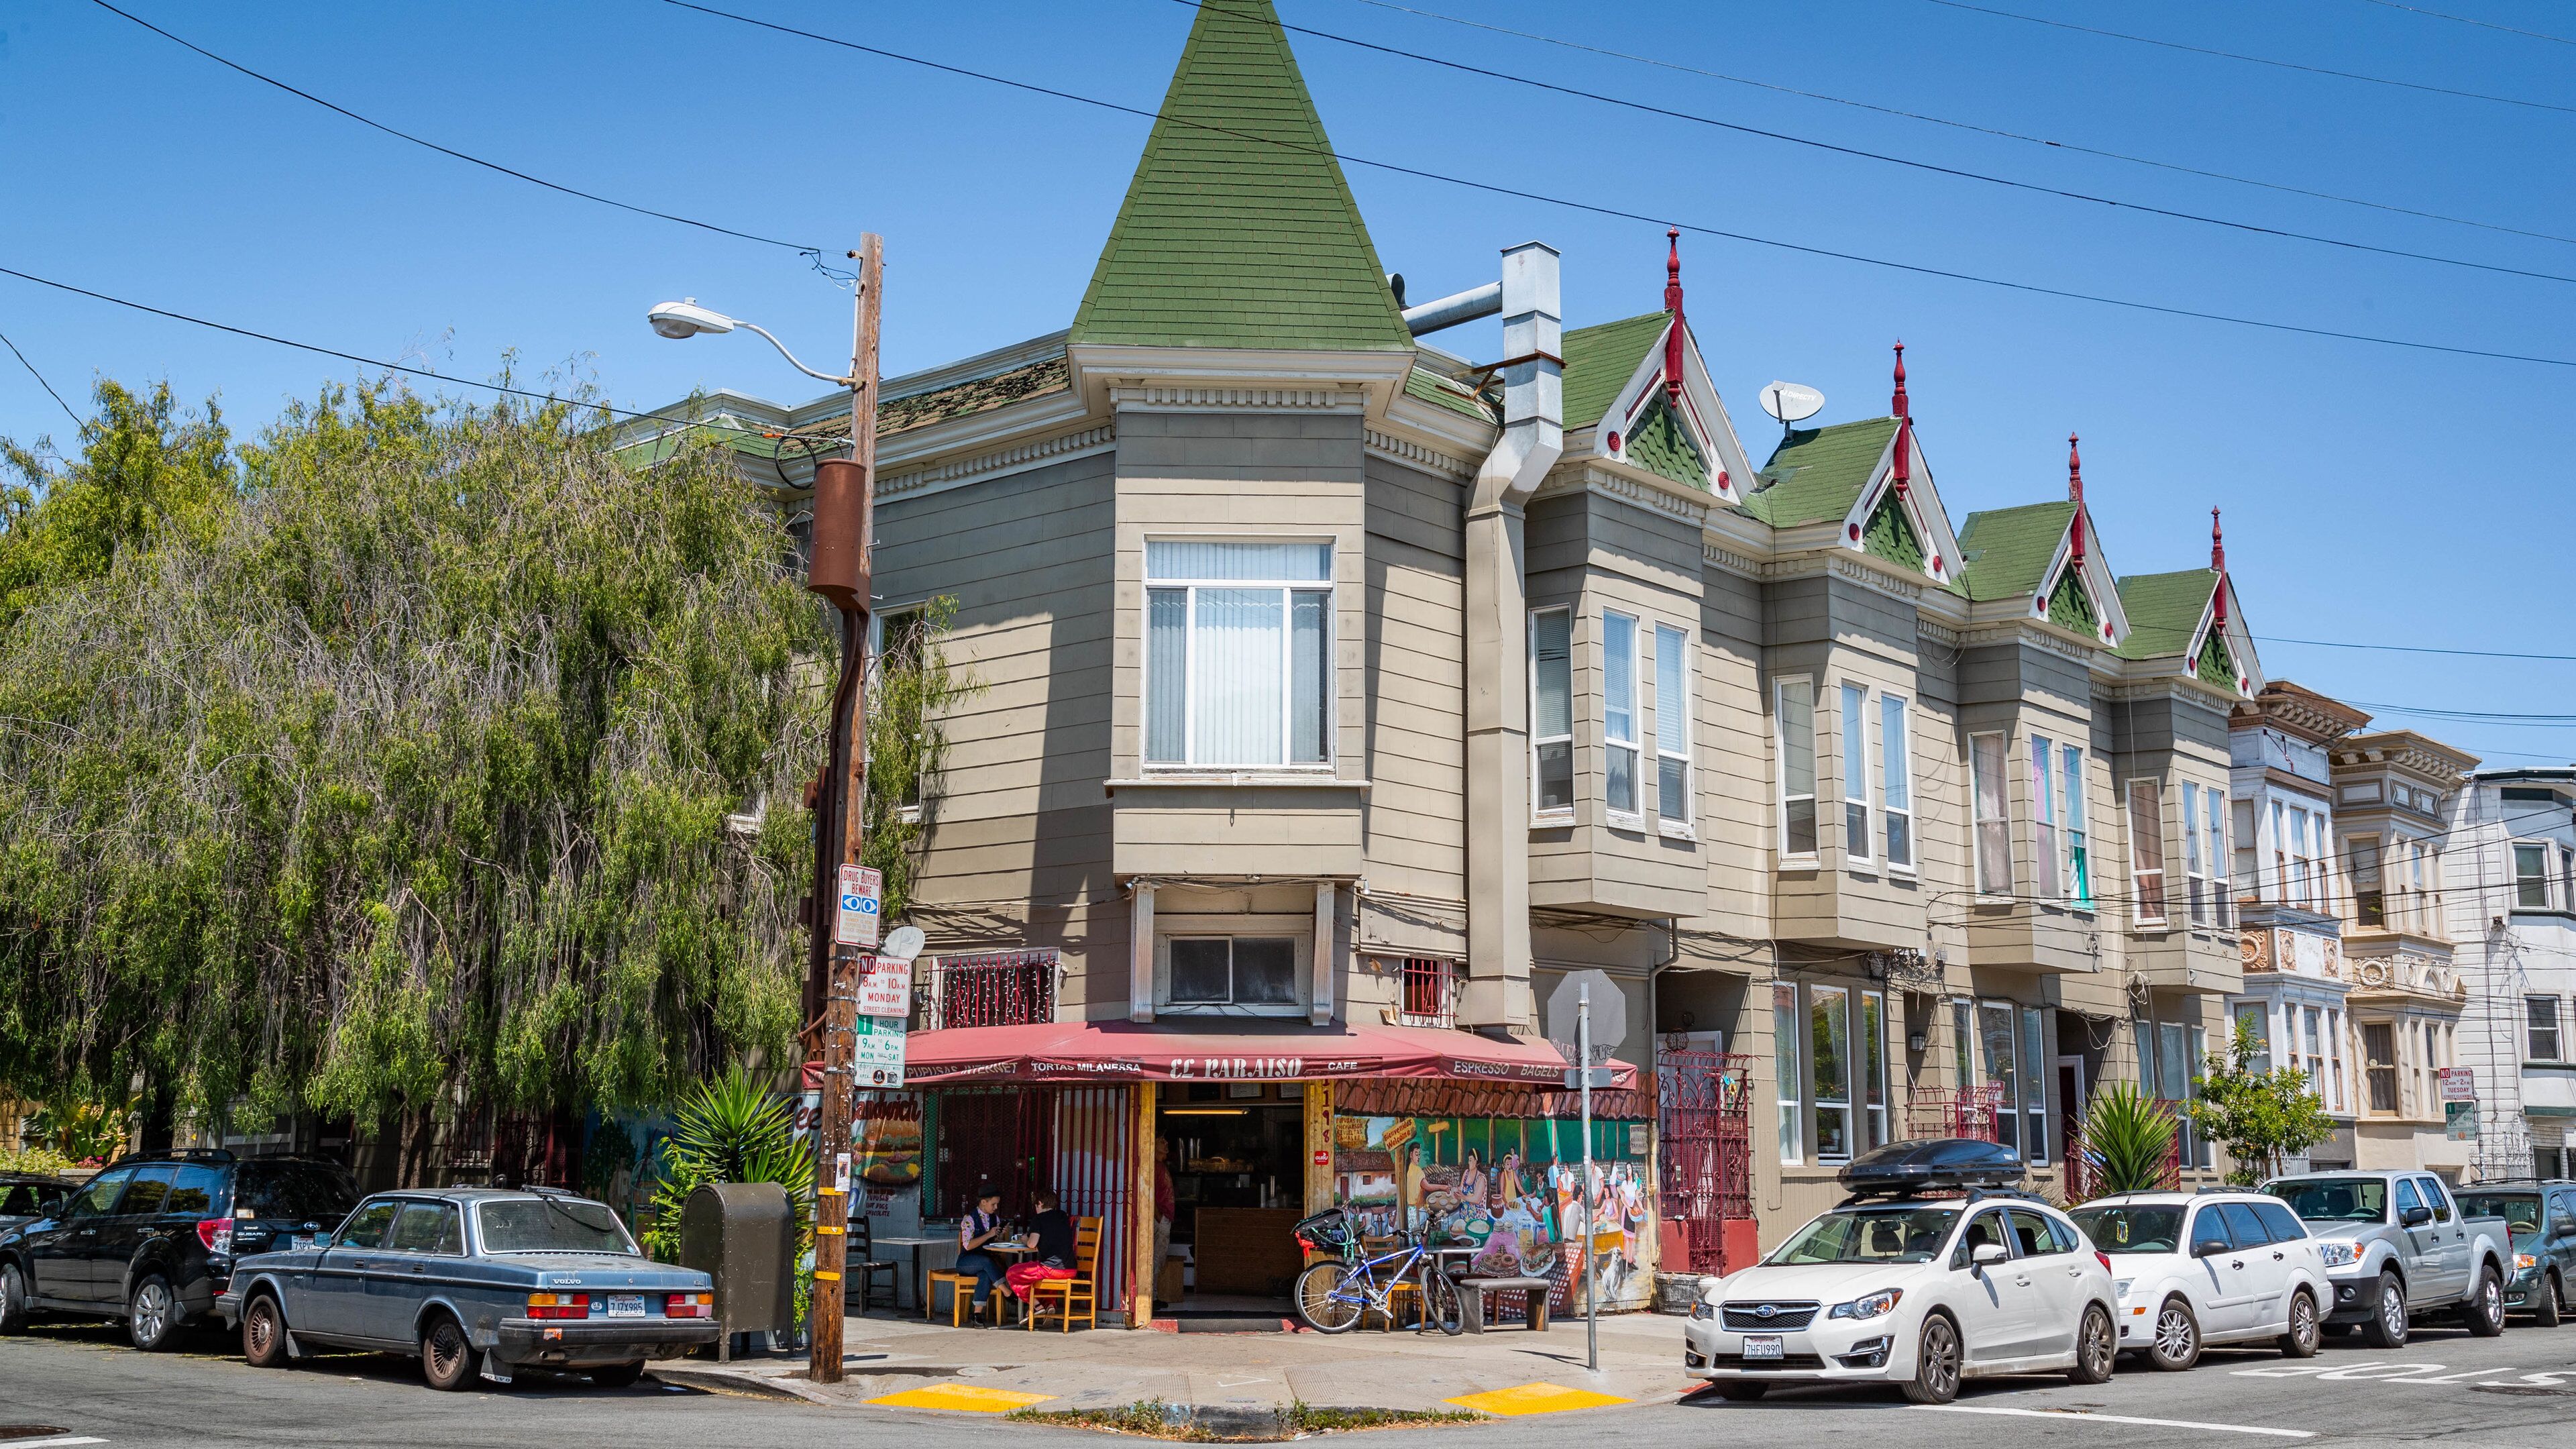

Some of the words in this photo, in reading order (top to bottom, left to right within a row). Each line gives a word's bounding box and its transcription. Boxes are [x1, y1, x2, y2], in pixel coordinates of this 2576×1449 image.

[843, 870, 859, 882] DRUG
[861, 873, 879, 886] BUYERS
[851, 883, 871, 897] BEWARE
[861, 957, 875, 973] NO
[877, 962, 908, 975] PARKING
[867, 993, 901, 1004] MONDAY
[863, 1017, 867, 1032] 1
[879, 1020, 899, 1028] HOUR
[873, 1028, 904, 1038] PARKING
[888, 1053, 900, 1061] SAT
[907, 1065, 958, 1078] PUPUSAS
[961, 1062, 1018, 1075] INTERNET
[1031, 1062, 1075, 1072] TORTAS
[1077, 1063, 1141, 1073] MILANESSA
[1170, 1059, 1195, 1079] EL
[1203, 1057, 1303, 1079] PARAISO
[1328, 1062, 1358, 1070] CAFE
[1454, 1061, 1510, 1075] ESPRESSO
[1520, 1064, 1560, 1077] BAGELS
[2440, 1069, 2449, 1077] NO
[851, 1091, 922, 1125] andwich
[1384, 1119, 1411, 1141] Bienvenidos
[1387, 1130, 1411, 1148] Welcome
[610, 1302, 643, 1313] 7JZX985
[1746, 1344, 1780, 1355] 7HFU990
